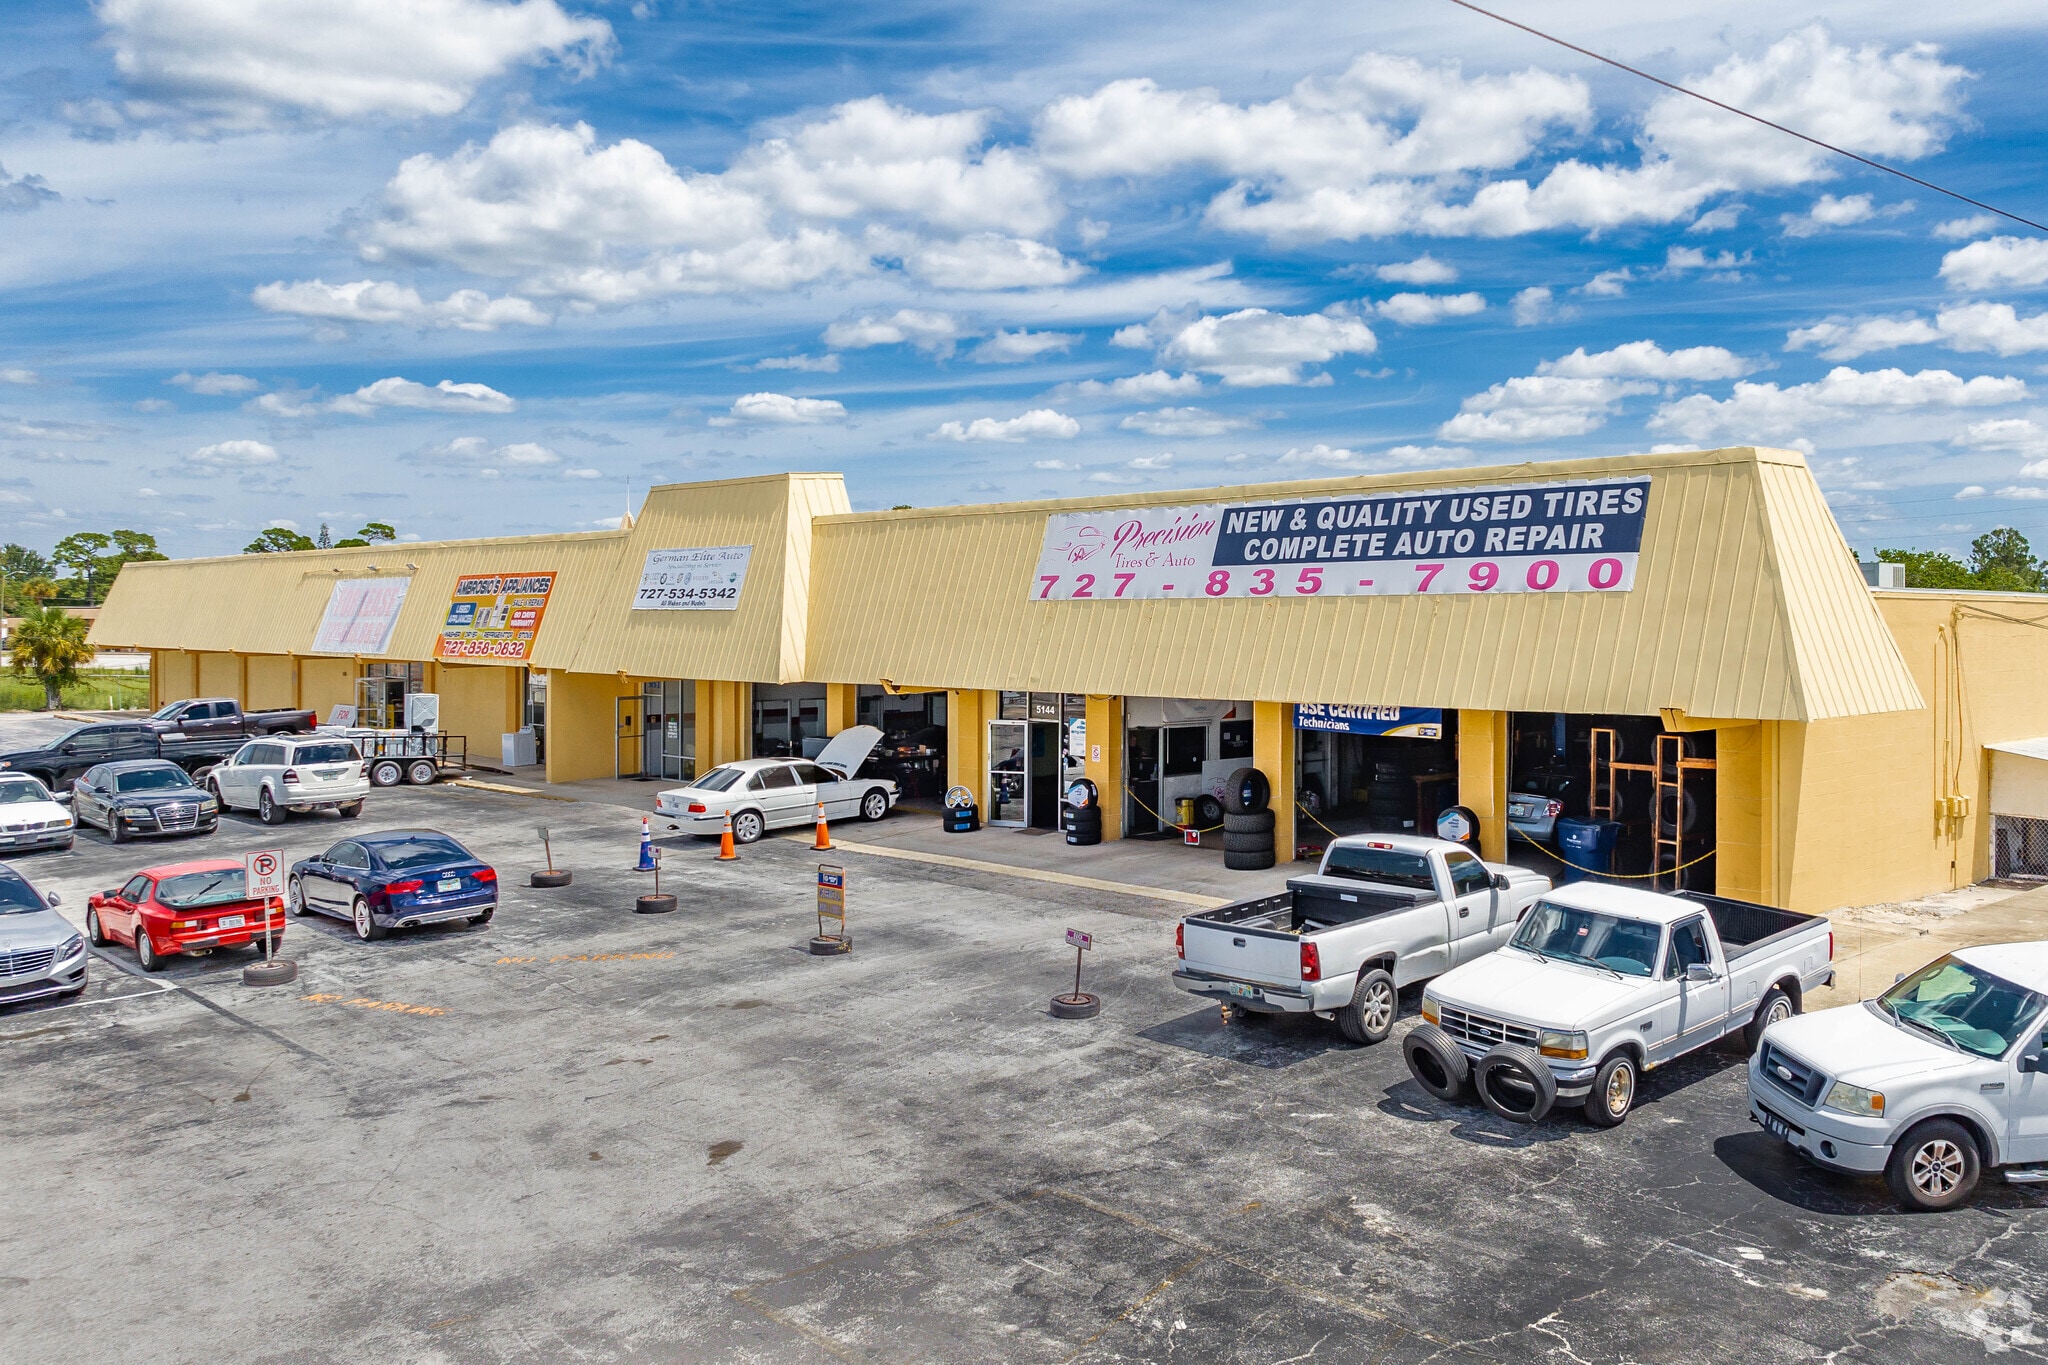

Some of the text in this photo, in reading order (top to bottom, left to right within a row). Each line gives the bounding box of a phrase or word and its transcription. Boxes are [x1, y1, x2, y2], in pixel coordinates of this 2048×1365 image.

[1226, 487, 1644, 534] NEW & QUALITY USED TIRES
[1110, 512, 1216, 558] Precision
[1243, 522, 1605, 561] COMPLETE AUTO REPAIR
[653, 550, 743, 565] German Elite Auto
[1114, 551, 1196, 568] Tires & Auto
[455, 576, 552, 595] AMBROSIO'S APPLIANCES
[640, 588, 737, 599] 727-534-5342
[358, 587, 400, 617] LEASE
[512, 598, 523, 607] SALE
[528, 598, 545, 607] REPAIR
[518, 631, 534, 639] STOVE
[443, 640, 526, 657] 727-858-0832
[337, 709, 350, 720] FOR
[1036, 705, 1055, 715] 5144
[1299, 703, 1400, 721] ASE CERTIFIED
[1299, 716, 1350, 731] Technicians
[259, 876, 272, 886] NO
[252, 885, 280, 895] PARKING
